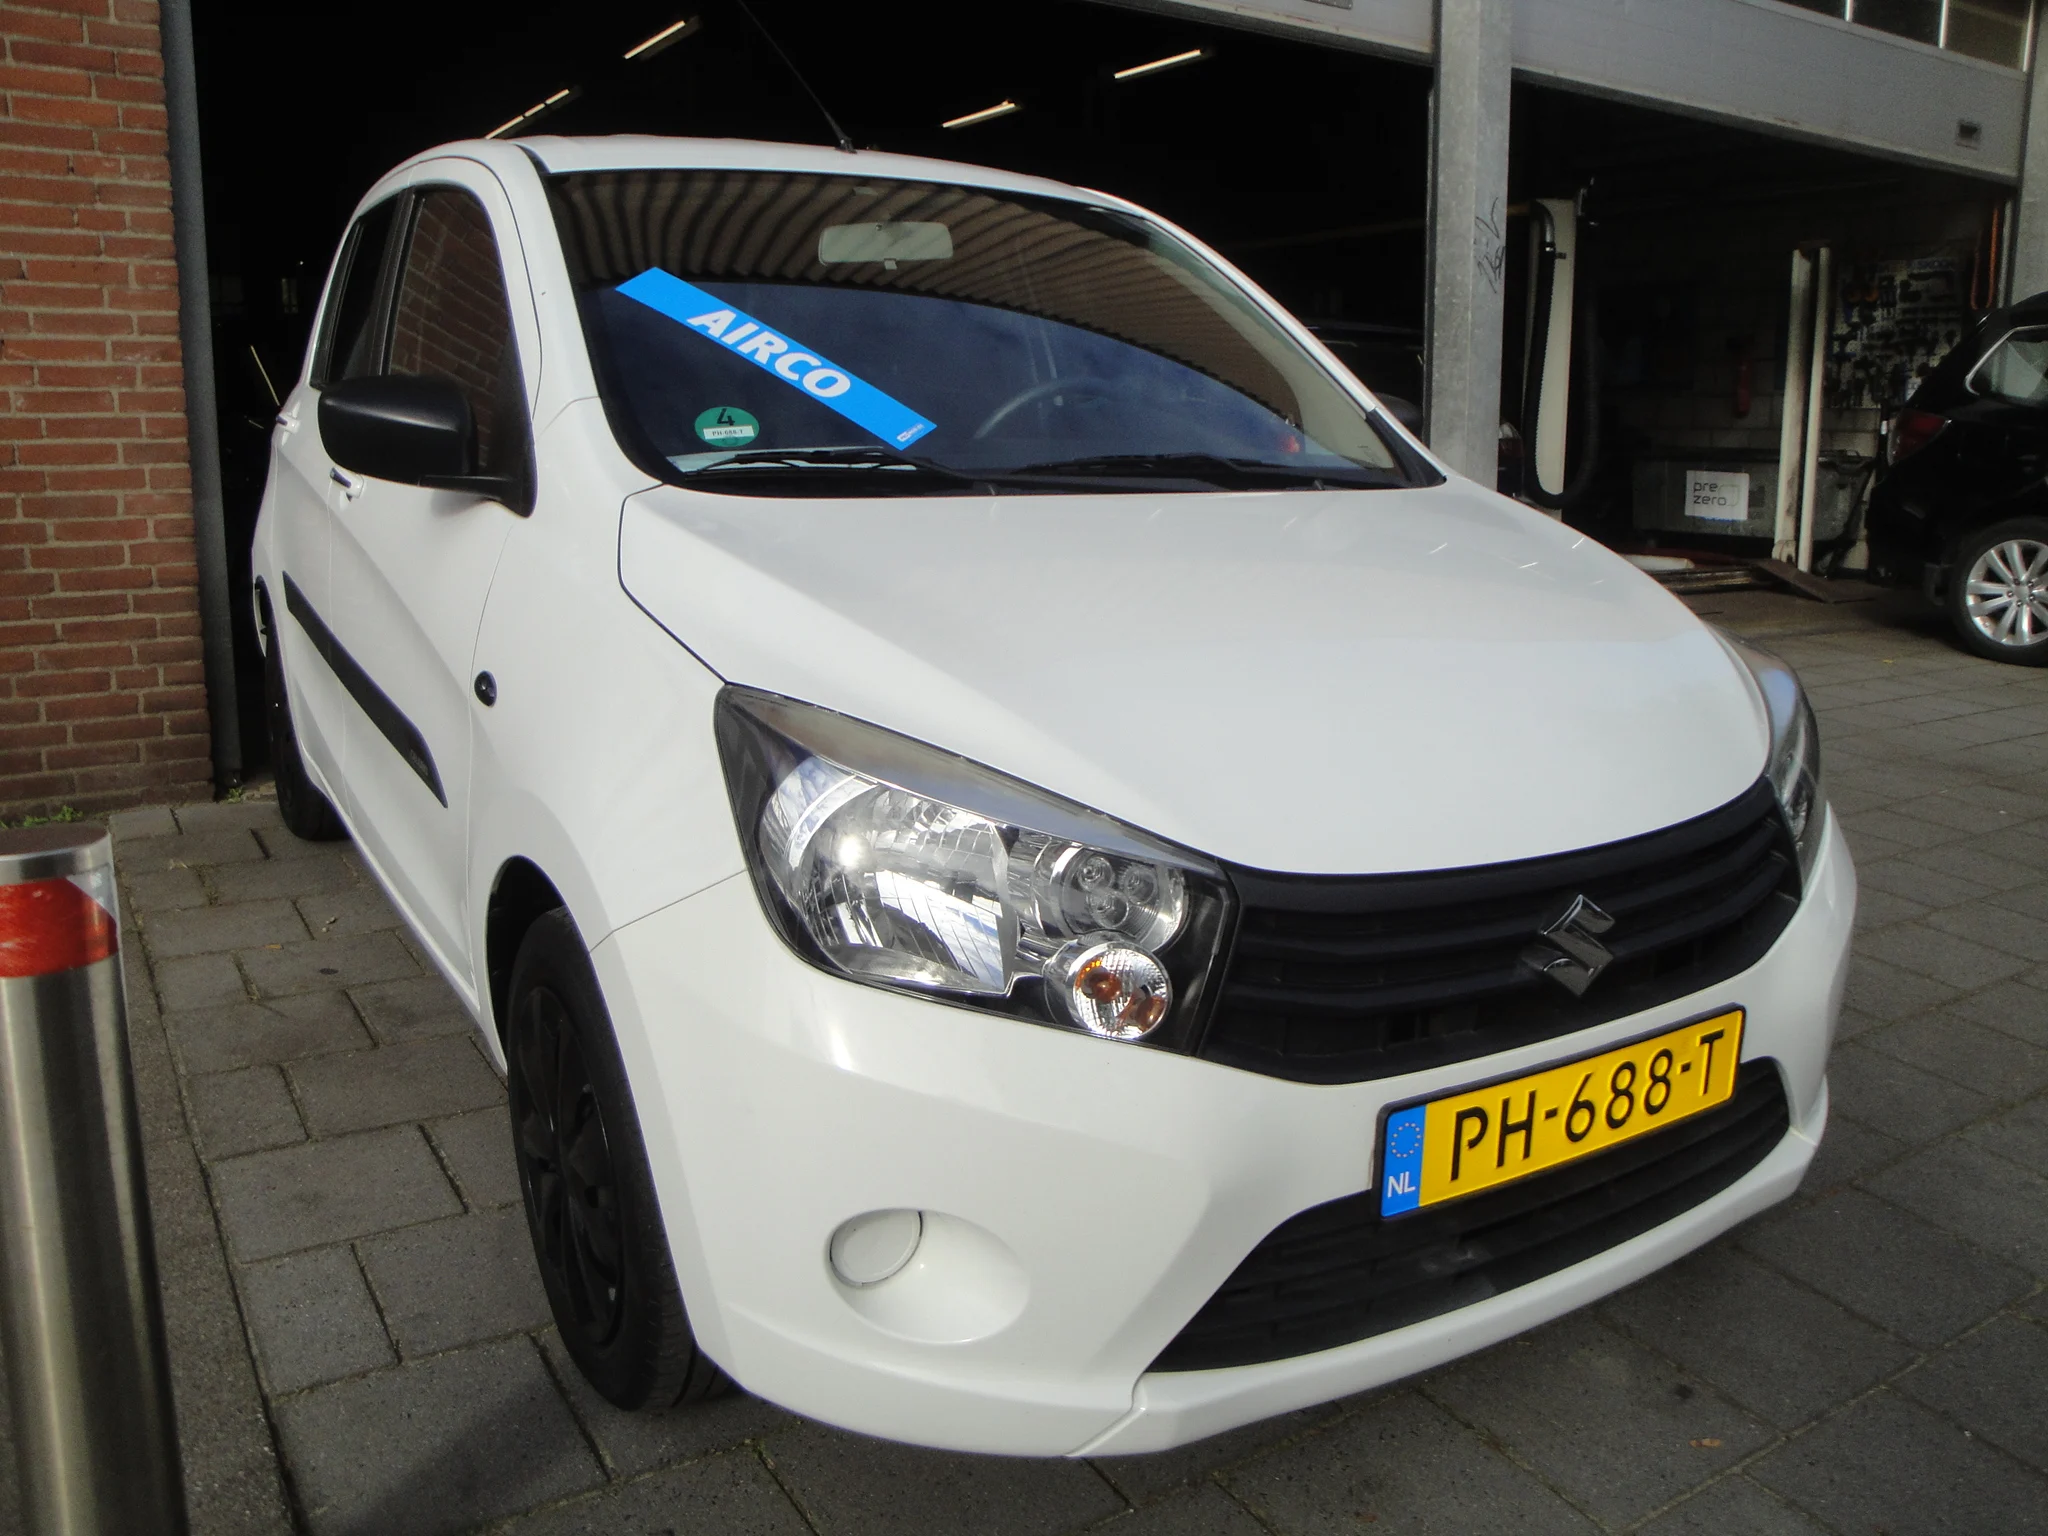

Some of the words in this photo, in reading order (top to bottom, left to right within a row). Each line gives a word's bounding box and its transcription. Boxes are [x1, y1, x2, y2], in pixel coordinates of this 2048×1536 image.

[687, 309, 851, 398] AIRCO
[716, 407, 736, 427] 4
[1693, 481, 1719, 494] pre
[1693, 494, 1728, 506] zero
[1449, 1028, 1726, 1183] PH-688-T
[1387, 1171, 1416, 1199] NL
